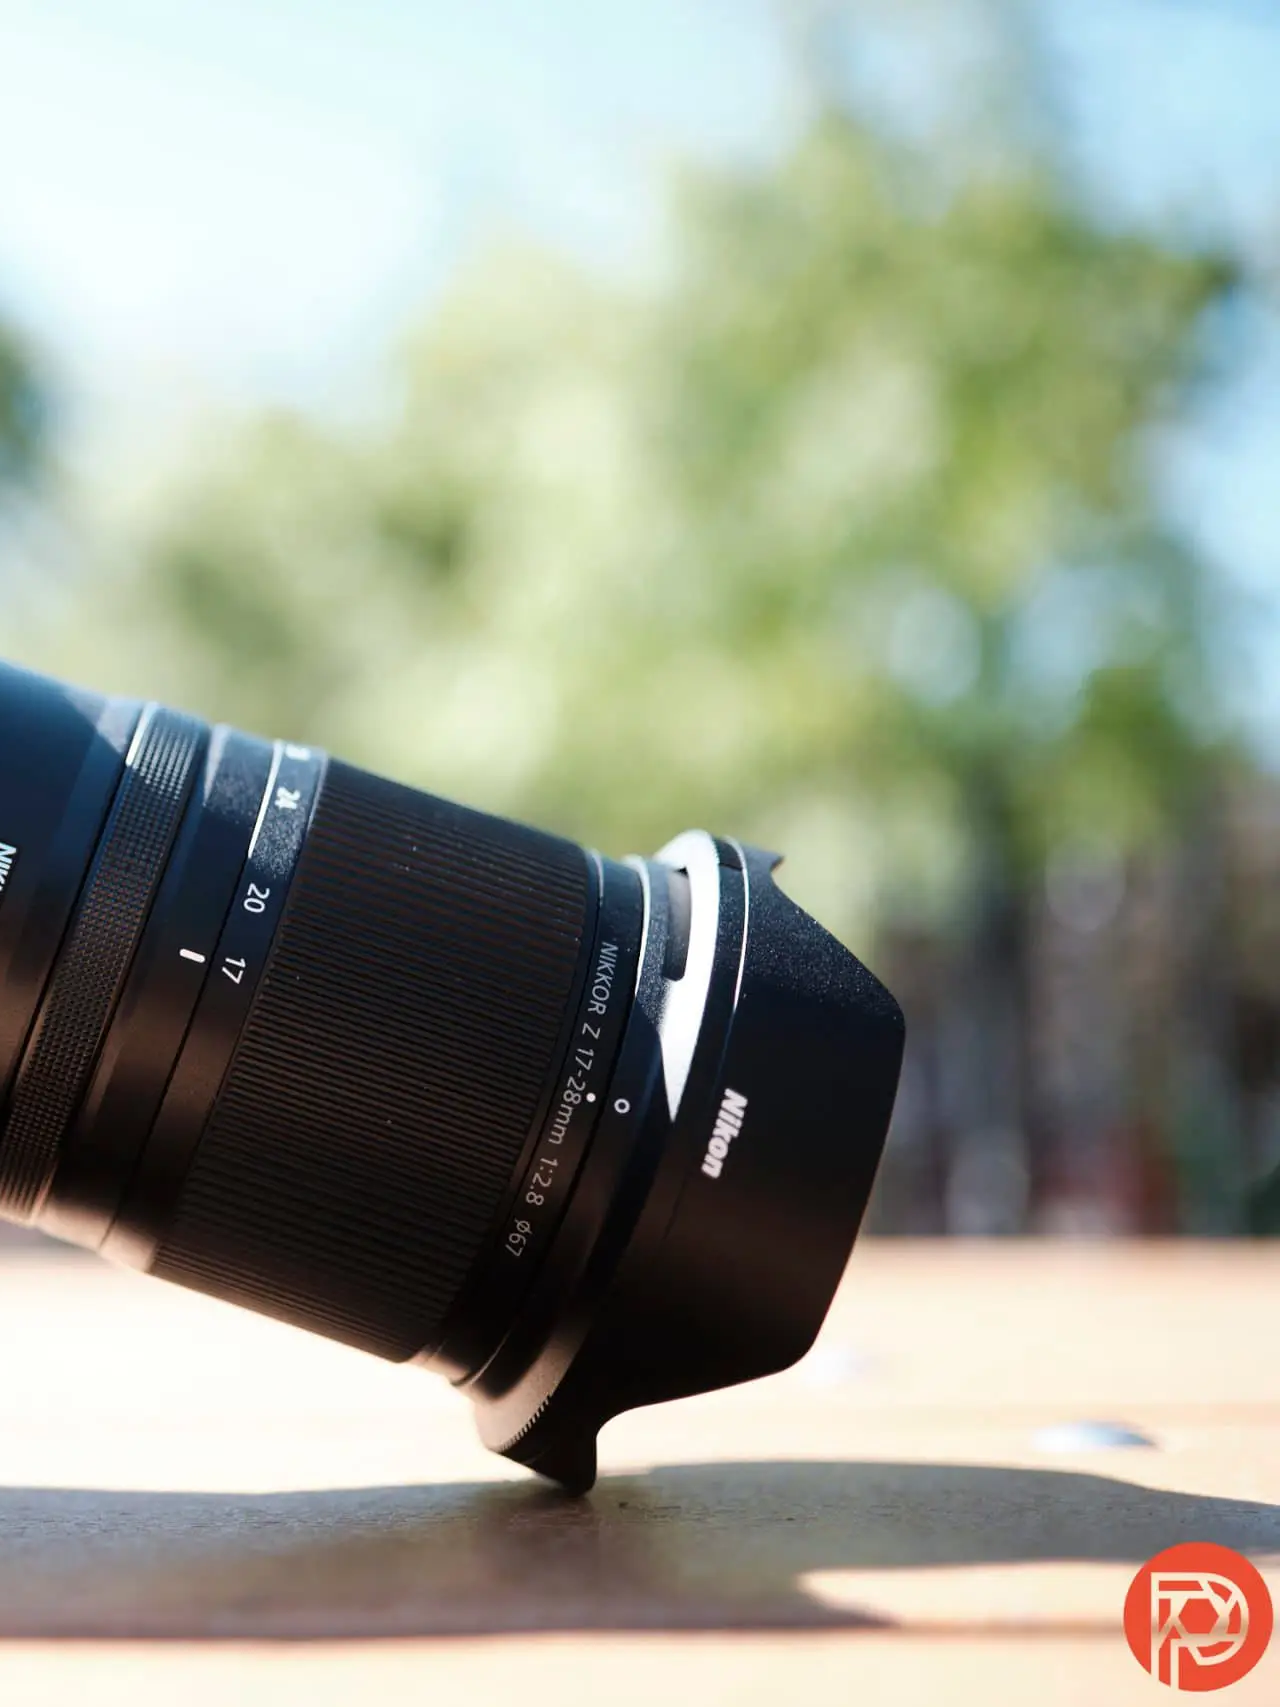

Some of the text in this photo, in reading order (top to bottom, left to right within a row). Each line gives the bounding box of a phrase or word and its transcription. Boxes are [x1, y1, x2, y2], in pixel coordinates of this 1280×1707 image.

[243, 883, 270, 913] 20
[221, 956, 246, 984] 17
[588, 942, 618, 1015] NIKKOR
[582, 1022, 601, 1040] Z
[548, 1048, 593, 1144] 17-28mm
[701, 1088, 749, 1179] Nikon
[525, 1156, 558, 1206] 1:2.8
